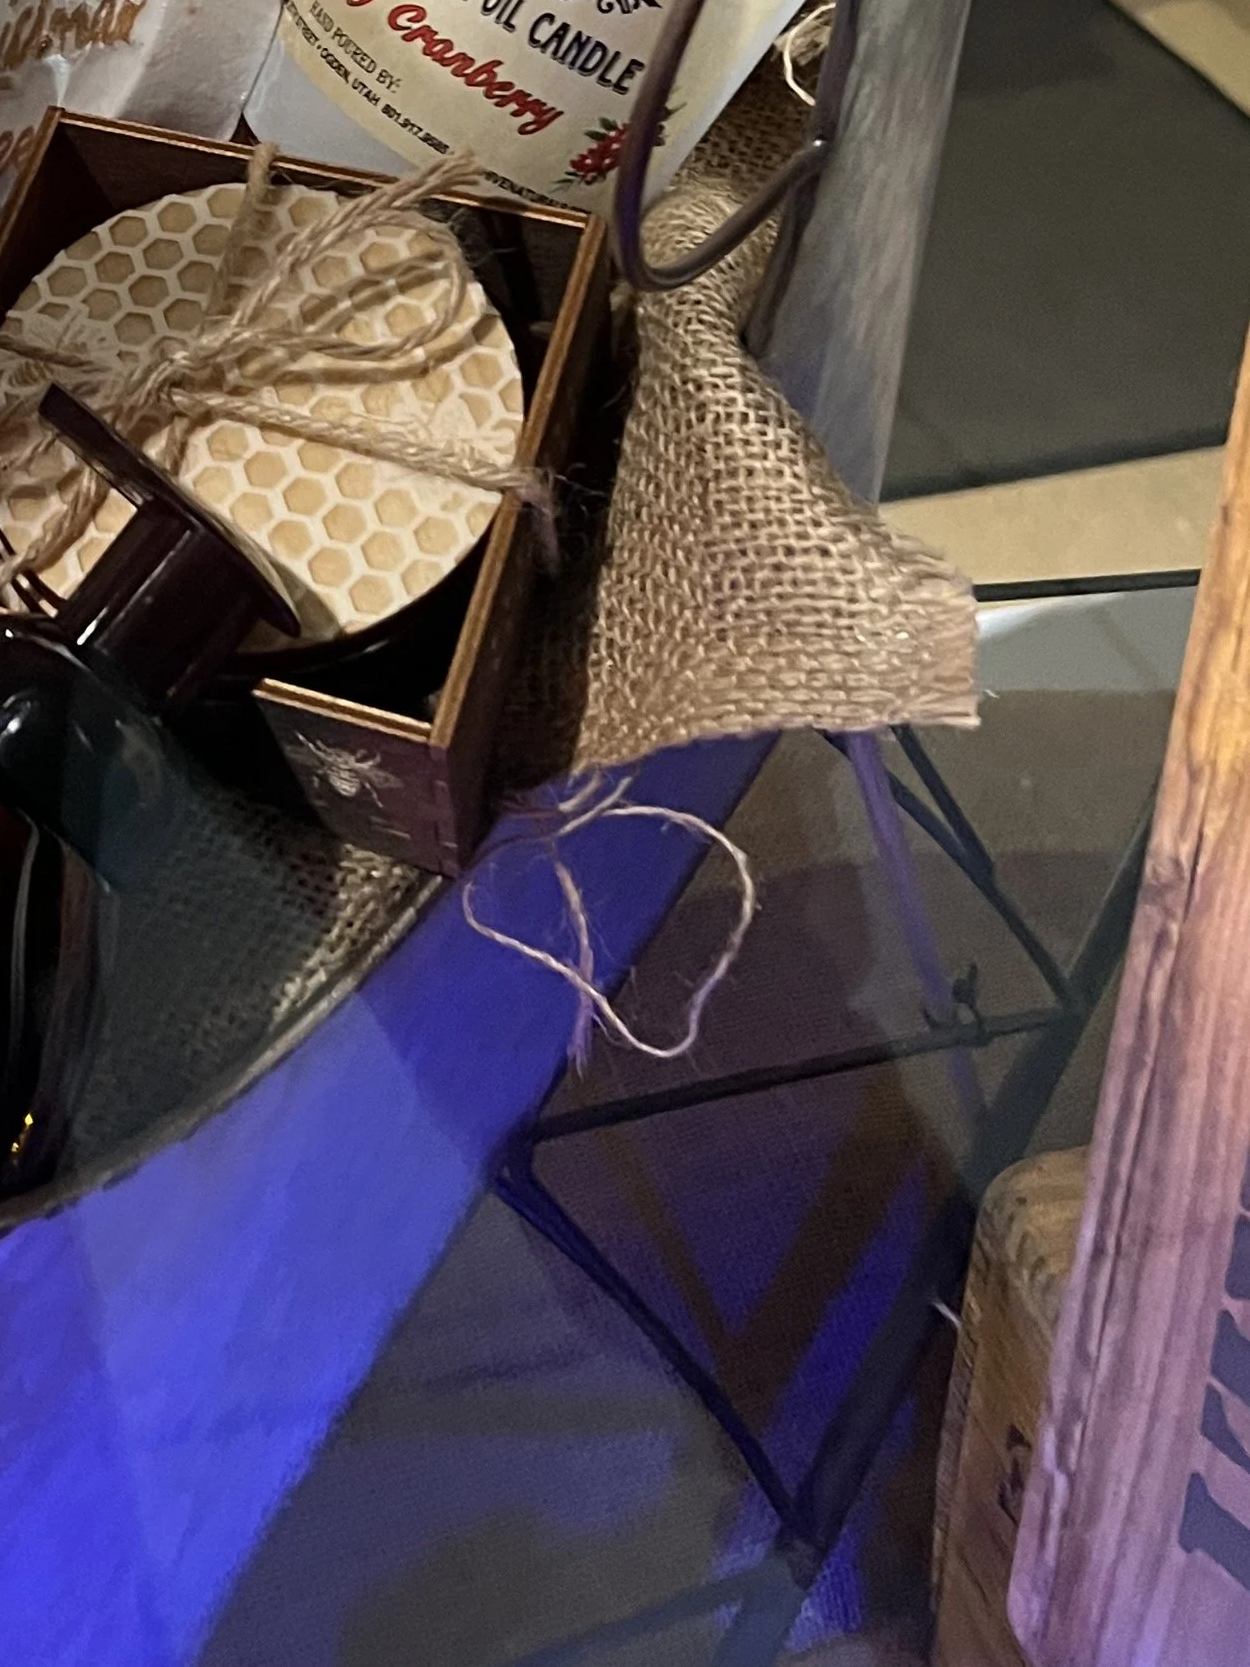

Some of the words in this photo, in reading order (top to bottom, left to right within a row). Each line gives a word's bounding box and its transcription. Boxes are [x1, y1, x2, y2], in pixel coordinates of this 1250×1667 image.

[332, 27, 377, 74] POURED
[387, 3, 565, 135] Cranberry
[528, 12, 645, 95] CANDLE
[351, 77, 382, 107] UTAH
